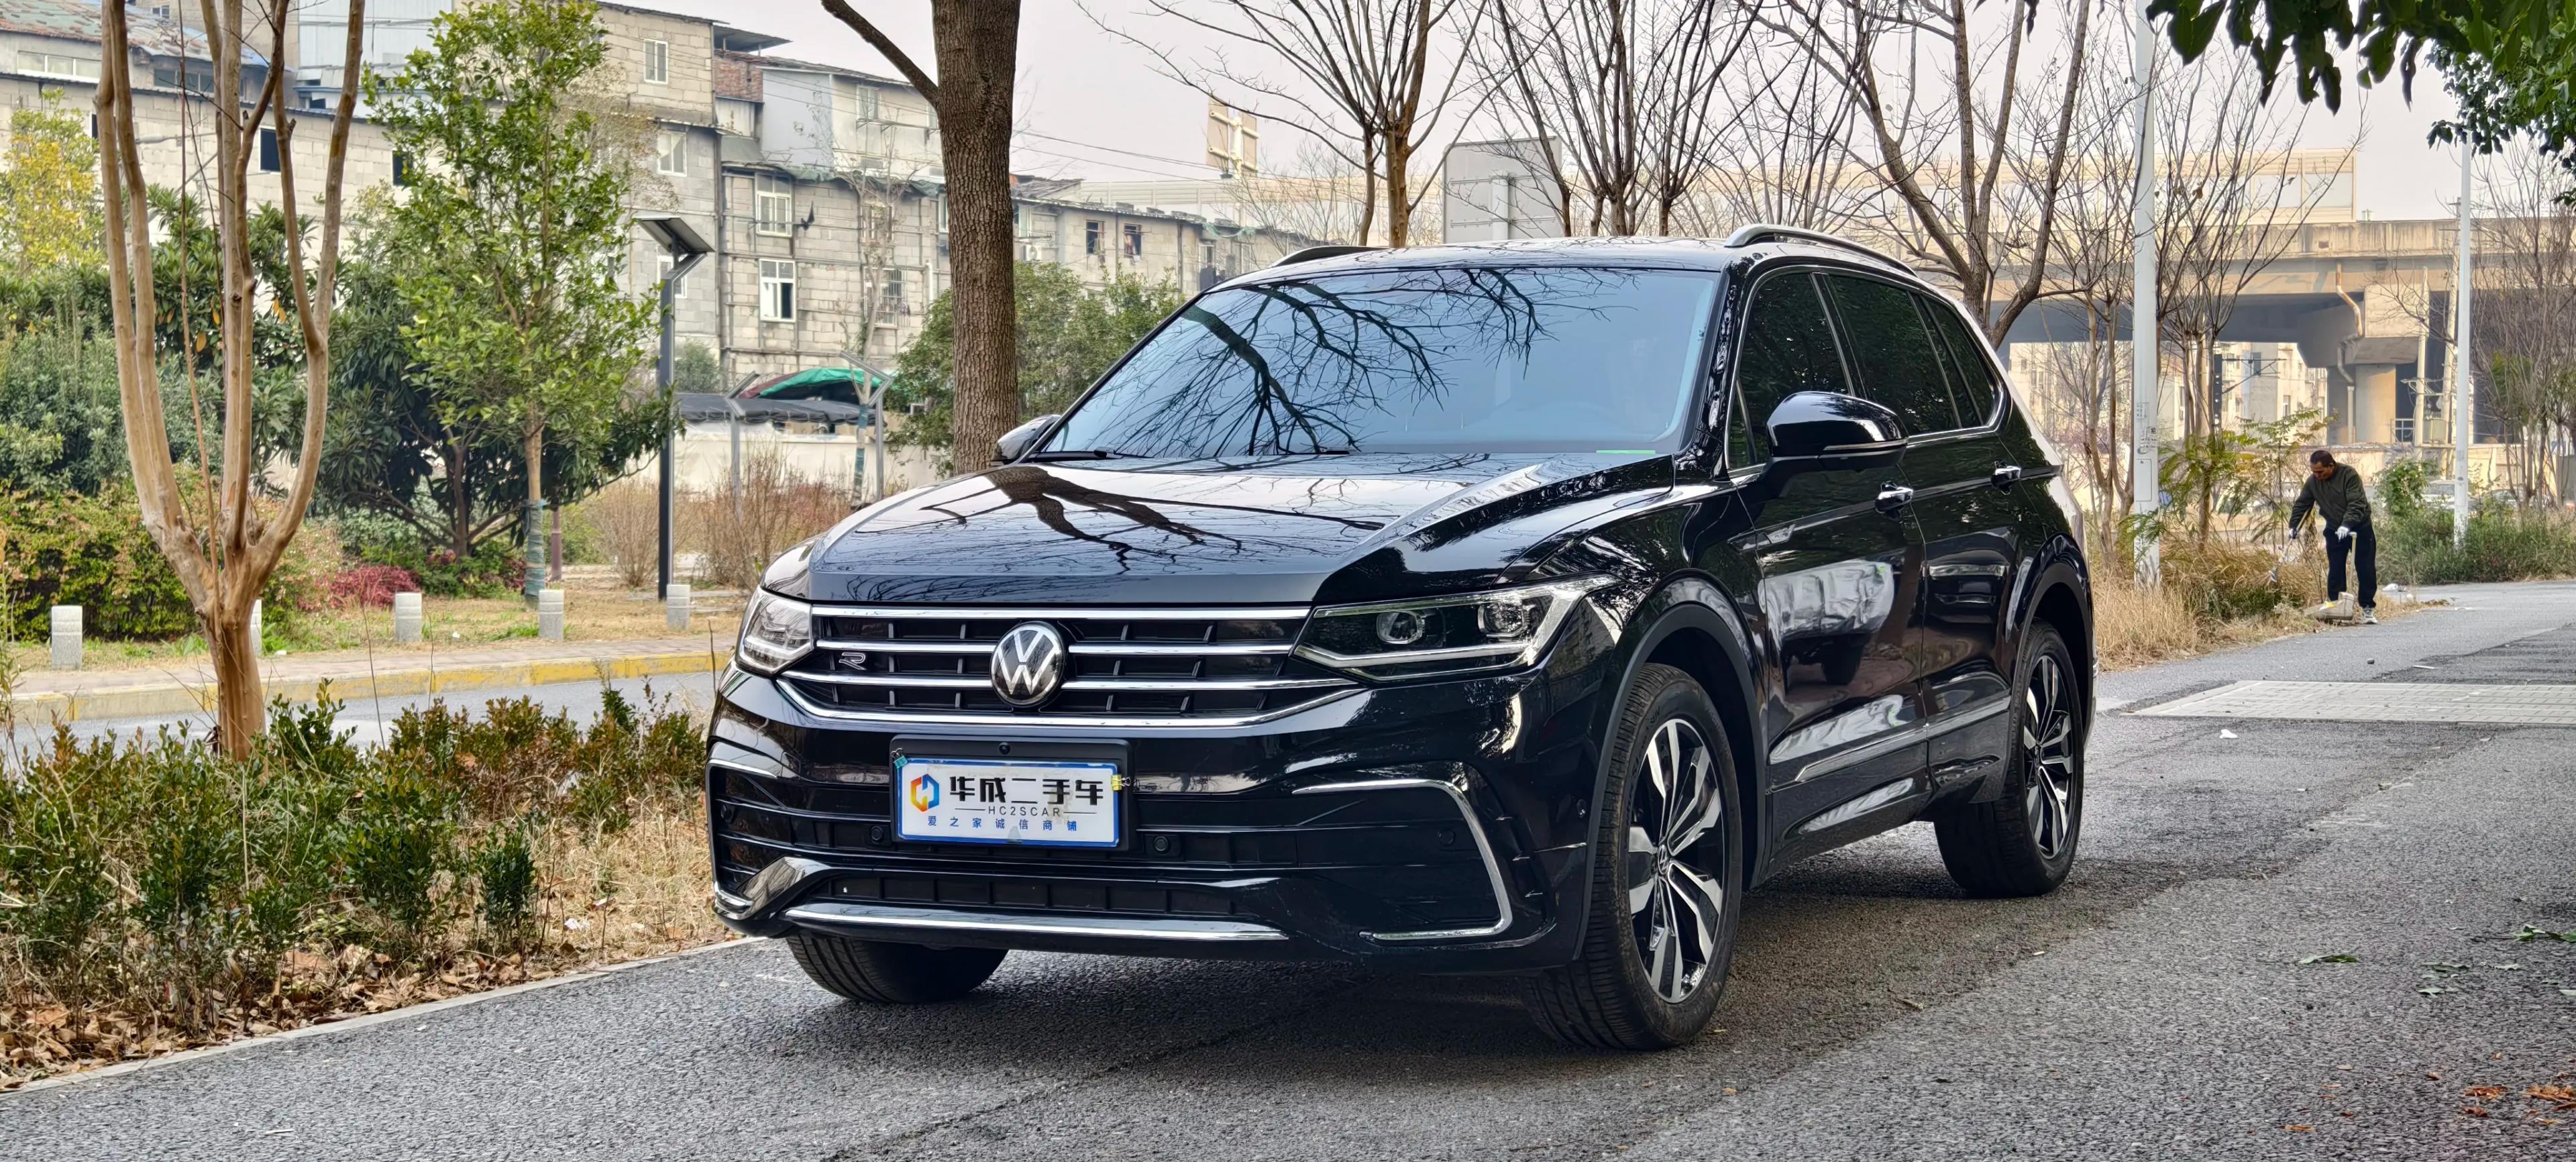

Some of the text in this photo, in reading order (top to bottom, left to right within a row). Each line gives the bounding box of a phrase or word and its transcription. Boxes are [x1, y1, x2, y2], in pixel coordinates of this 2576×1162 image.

[949, 776, 1104, 806] 华成二手车
[988, 805, 1061, 816] HC2SCAR
